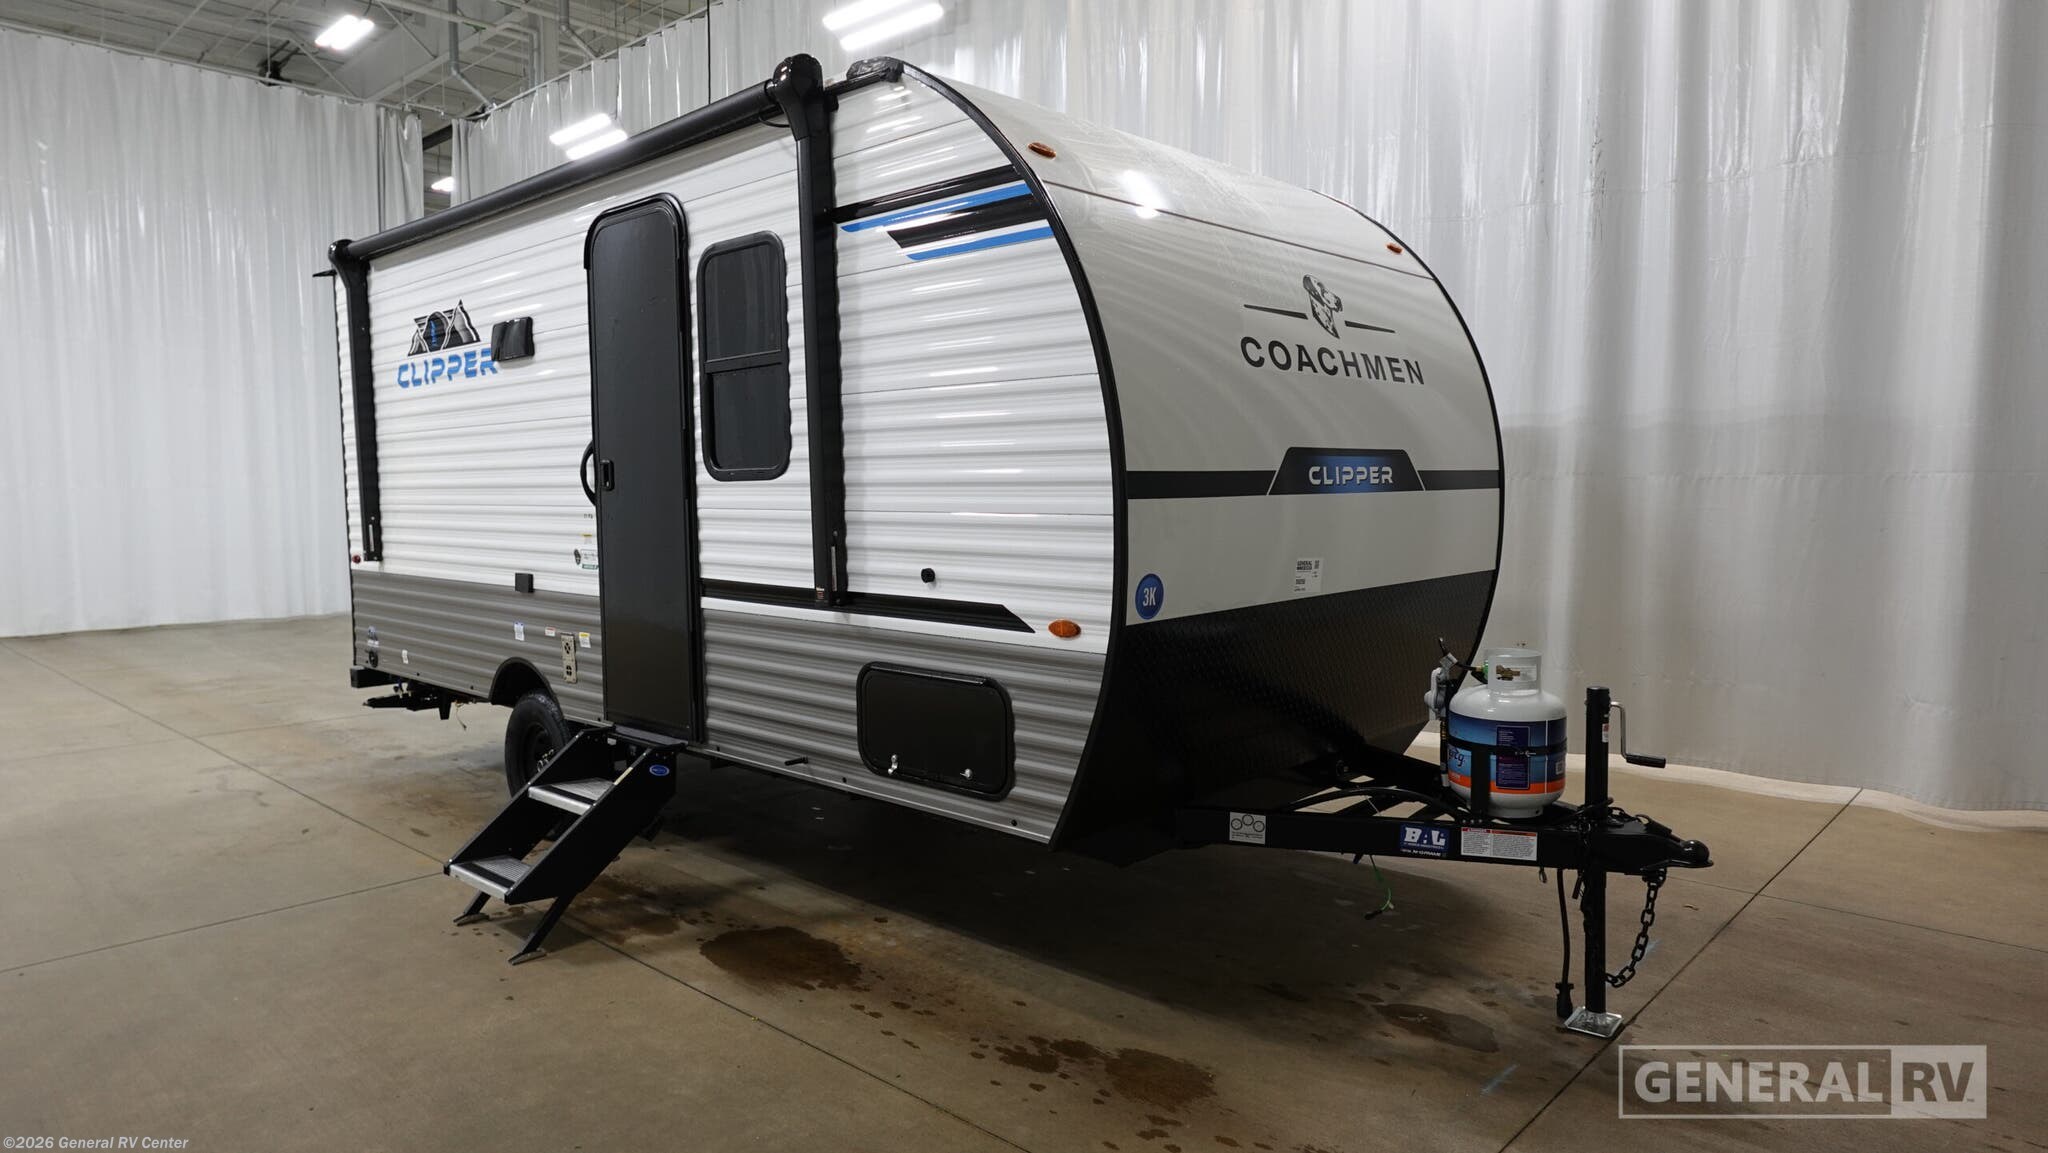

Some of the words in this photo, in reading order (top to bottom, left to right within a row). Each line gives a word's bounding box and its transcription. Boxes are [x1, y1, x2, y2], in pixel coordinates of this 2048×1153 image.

[397, 347, 498, 389] CLIPPER
[1240, 336, 1425, 385] COACHMEN
[1308, 466, 1394, 485] CLIPPER
[1142, 587, 1157, 607] 3K
